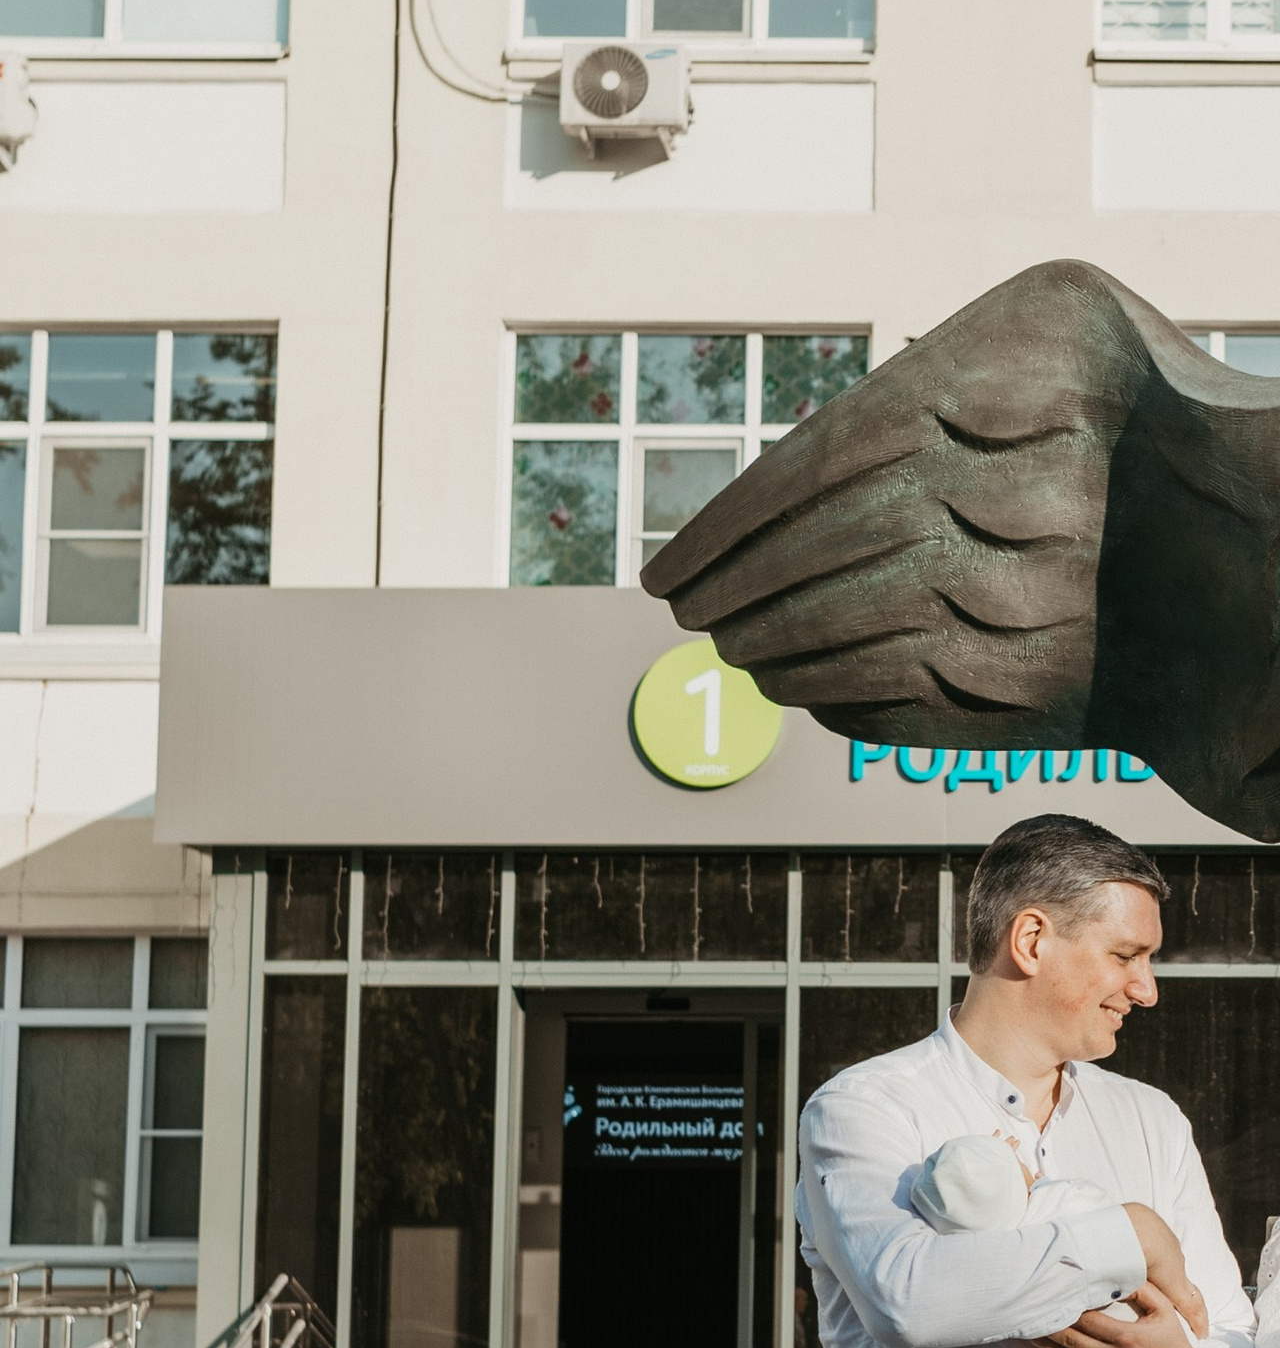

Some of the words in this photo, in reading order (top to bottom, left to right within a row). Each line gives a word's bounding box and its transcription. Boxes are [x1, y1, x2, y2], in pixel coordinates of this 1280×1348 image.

[684, 669, 721, 756] 1
[620, 1096, 633, 1108] А.
[635, 1096, 648, 1108] К.
[595, 1117, 715, 1139] Родильный
